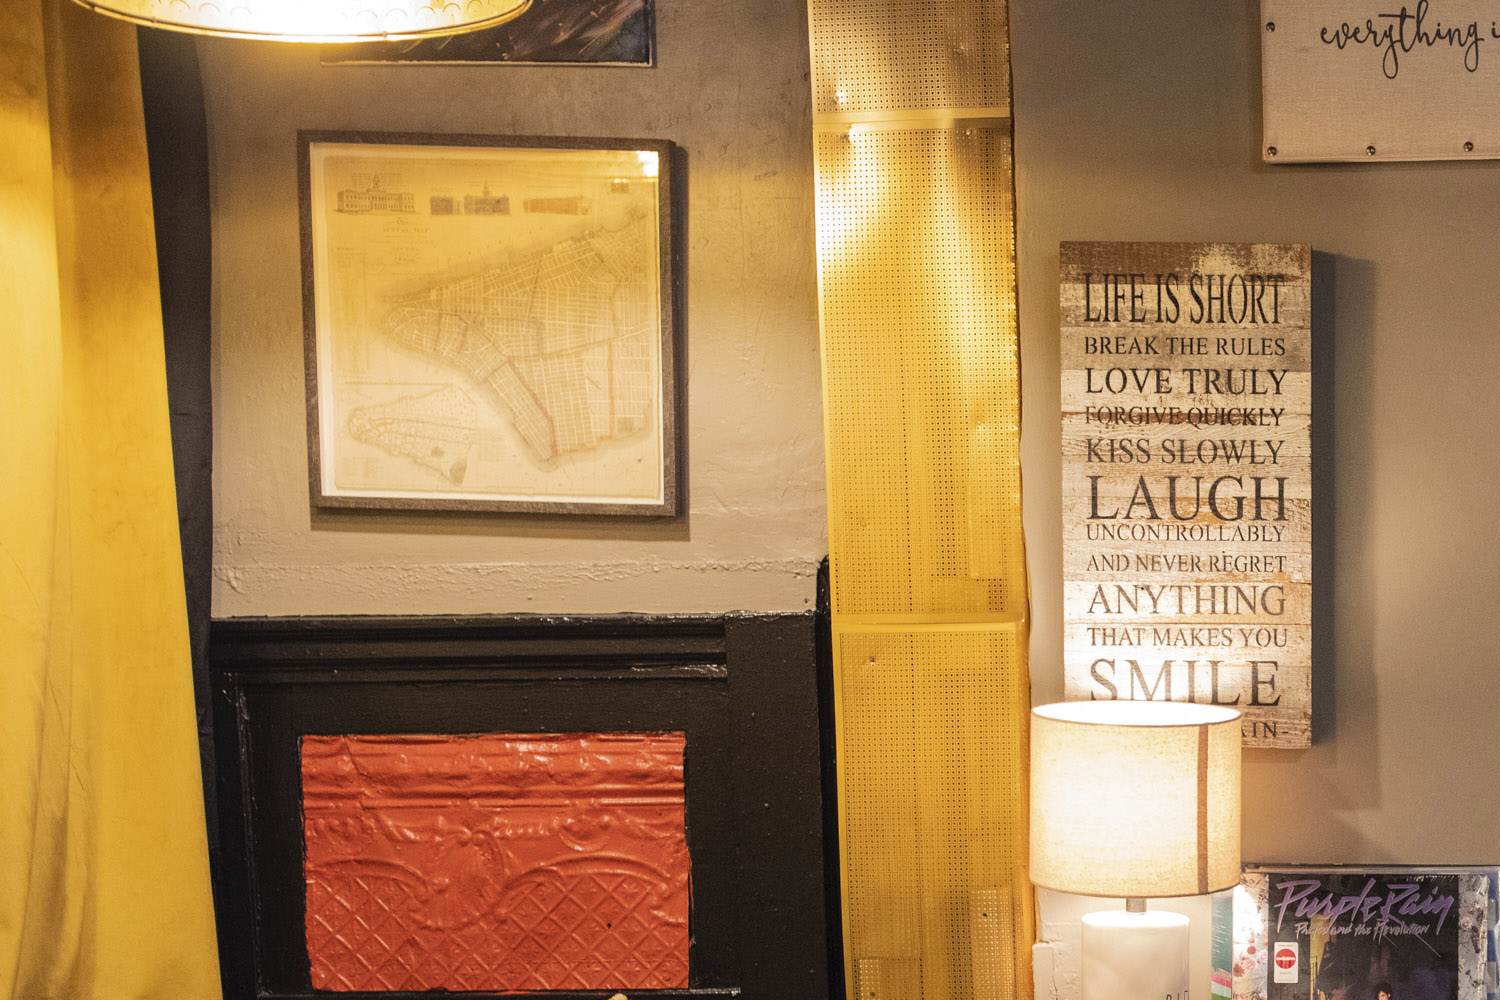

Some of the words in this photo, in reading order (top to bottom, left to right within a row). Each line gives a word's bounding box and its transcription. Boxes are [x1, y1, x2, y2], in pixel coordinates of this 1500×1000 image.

[1320, 0, 1485, 79] everything
[1083, 272, 1147, 324] LIFE
[1156, 272, 1180, 323] IS
[1188, 272, 1286, 325] SHORT
[1083, 337, 1160, 356] BREAK
[1165, 337, 1210, 356] THE
[1216, 337, 1286, 356] RULES
[1085, 367, 1173, 395] LOVE
[1181, 367, 1288, 396] TRULY
[1085, 406, 1181, 426] FORGIVE
[1186, 407, 1285, 428] QUICKLY
[1086, 438, 1151, 465] KISS
[1160, 438, 1285, 465] SLOWLY
[1087, 475, 1288, 523] LAUGH
[1086, 524, 1286, 542] UNCONTROLLABLY
[1086, 555, 1132, 573] AND
[1136, 555, 1204, 573] NEVER
[1208, 555, 1287, 573] REGRET
[1087, 584, 1287, 616] ANYTHING
[1087, 628, 1148, 647] THAT
[1152, 628, 1233, 647] MAKES
[1238, 628, 1288, 647] YOU
[1090, 658, 1282, 707] SMILE
[1274, 878, 1378, 934] Purple
[1377, 884, 1455, 948] Rain
[1354, 923, 1371, 936] the
